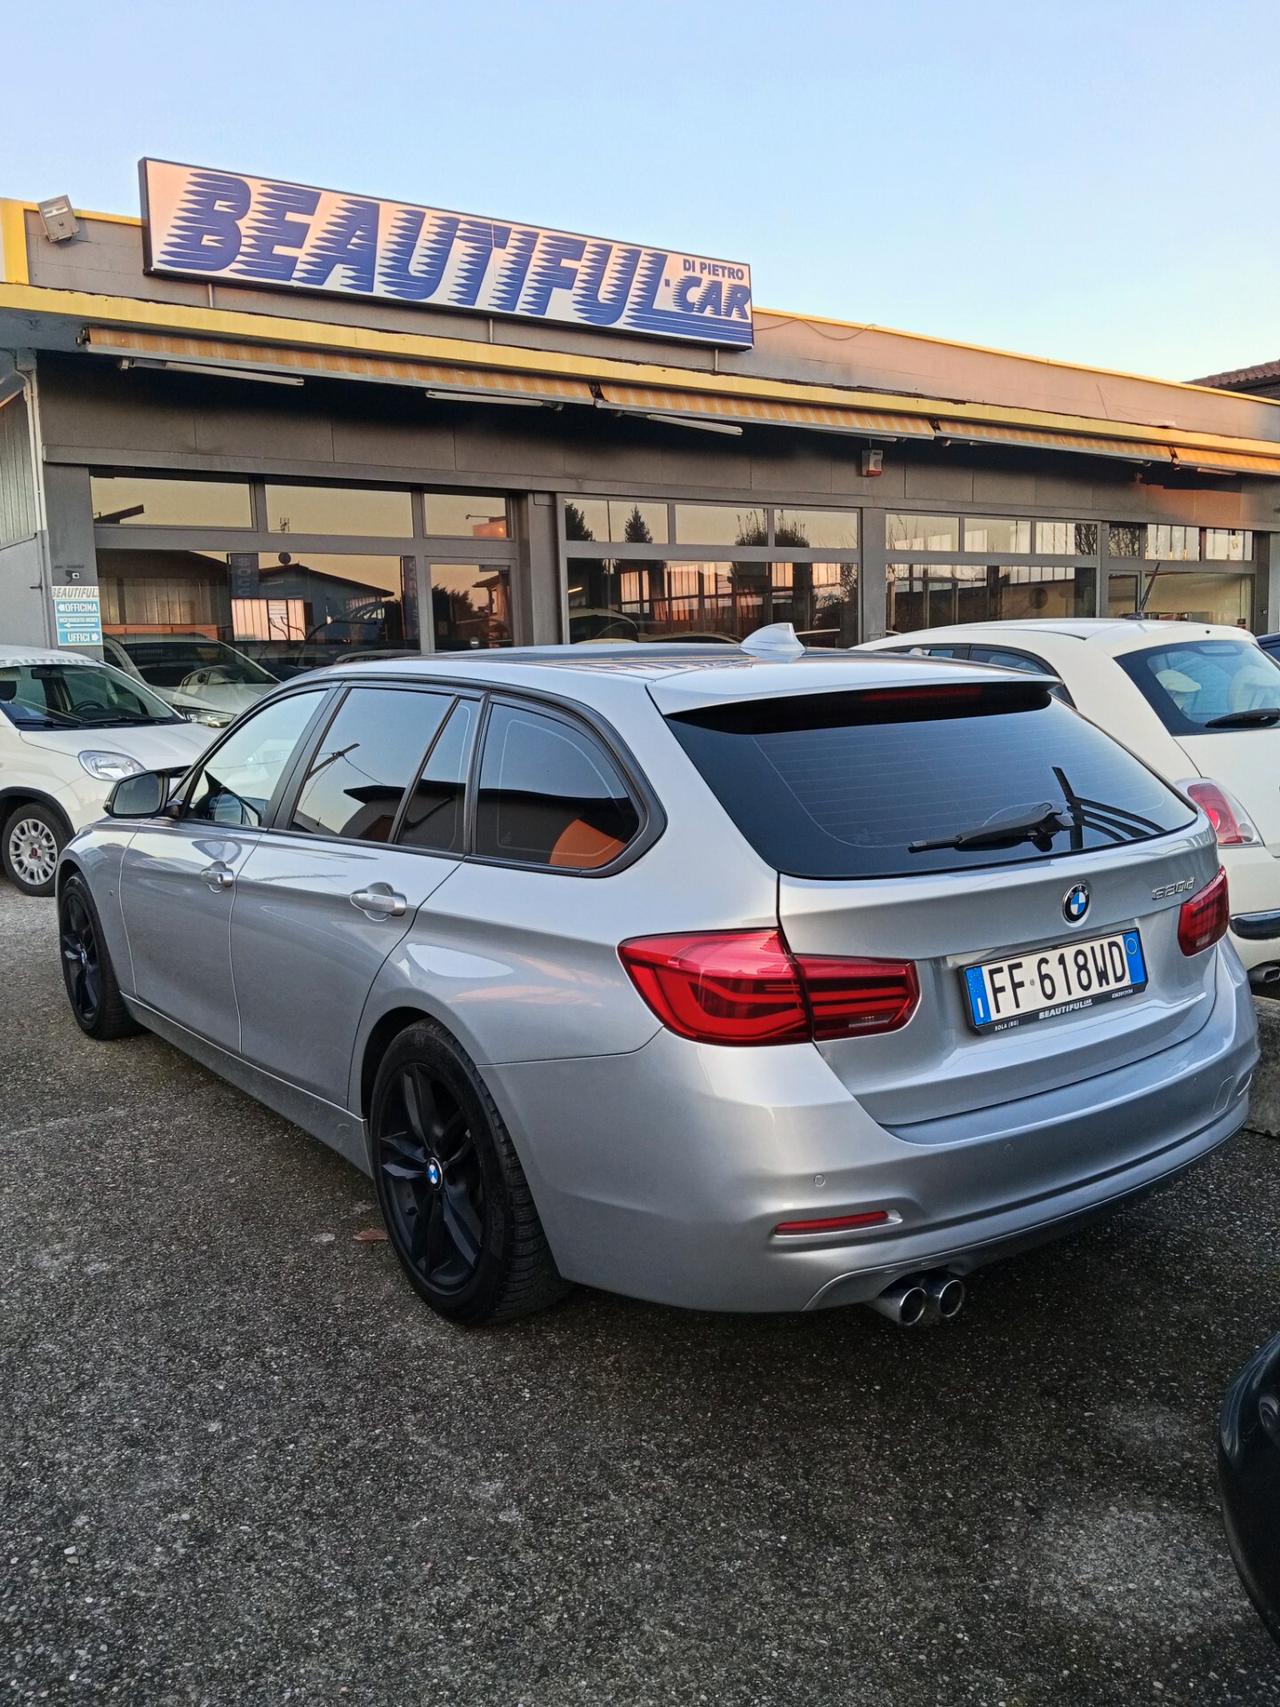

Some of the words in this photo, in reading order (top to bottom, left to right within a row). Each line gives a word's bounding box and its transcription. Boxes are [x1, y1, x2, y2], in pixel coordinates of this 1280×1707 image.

[159, 171, 667, 332] BEAUTIFUL
[683, 258, 696, 273] DI
[700, 261, 745, 281] PIETRO
[672, 275, 752, 321] CAR
[65, 602, 98, 612] OFFICINA
[67, 632, 90, 642] UFFICI
[1039, 1001, 1090, 1020] BEAUTIFUL
